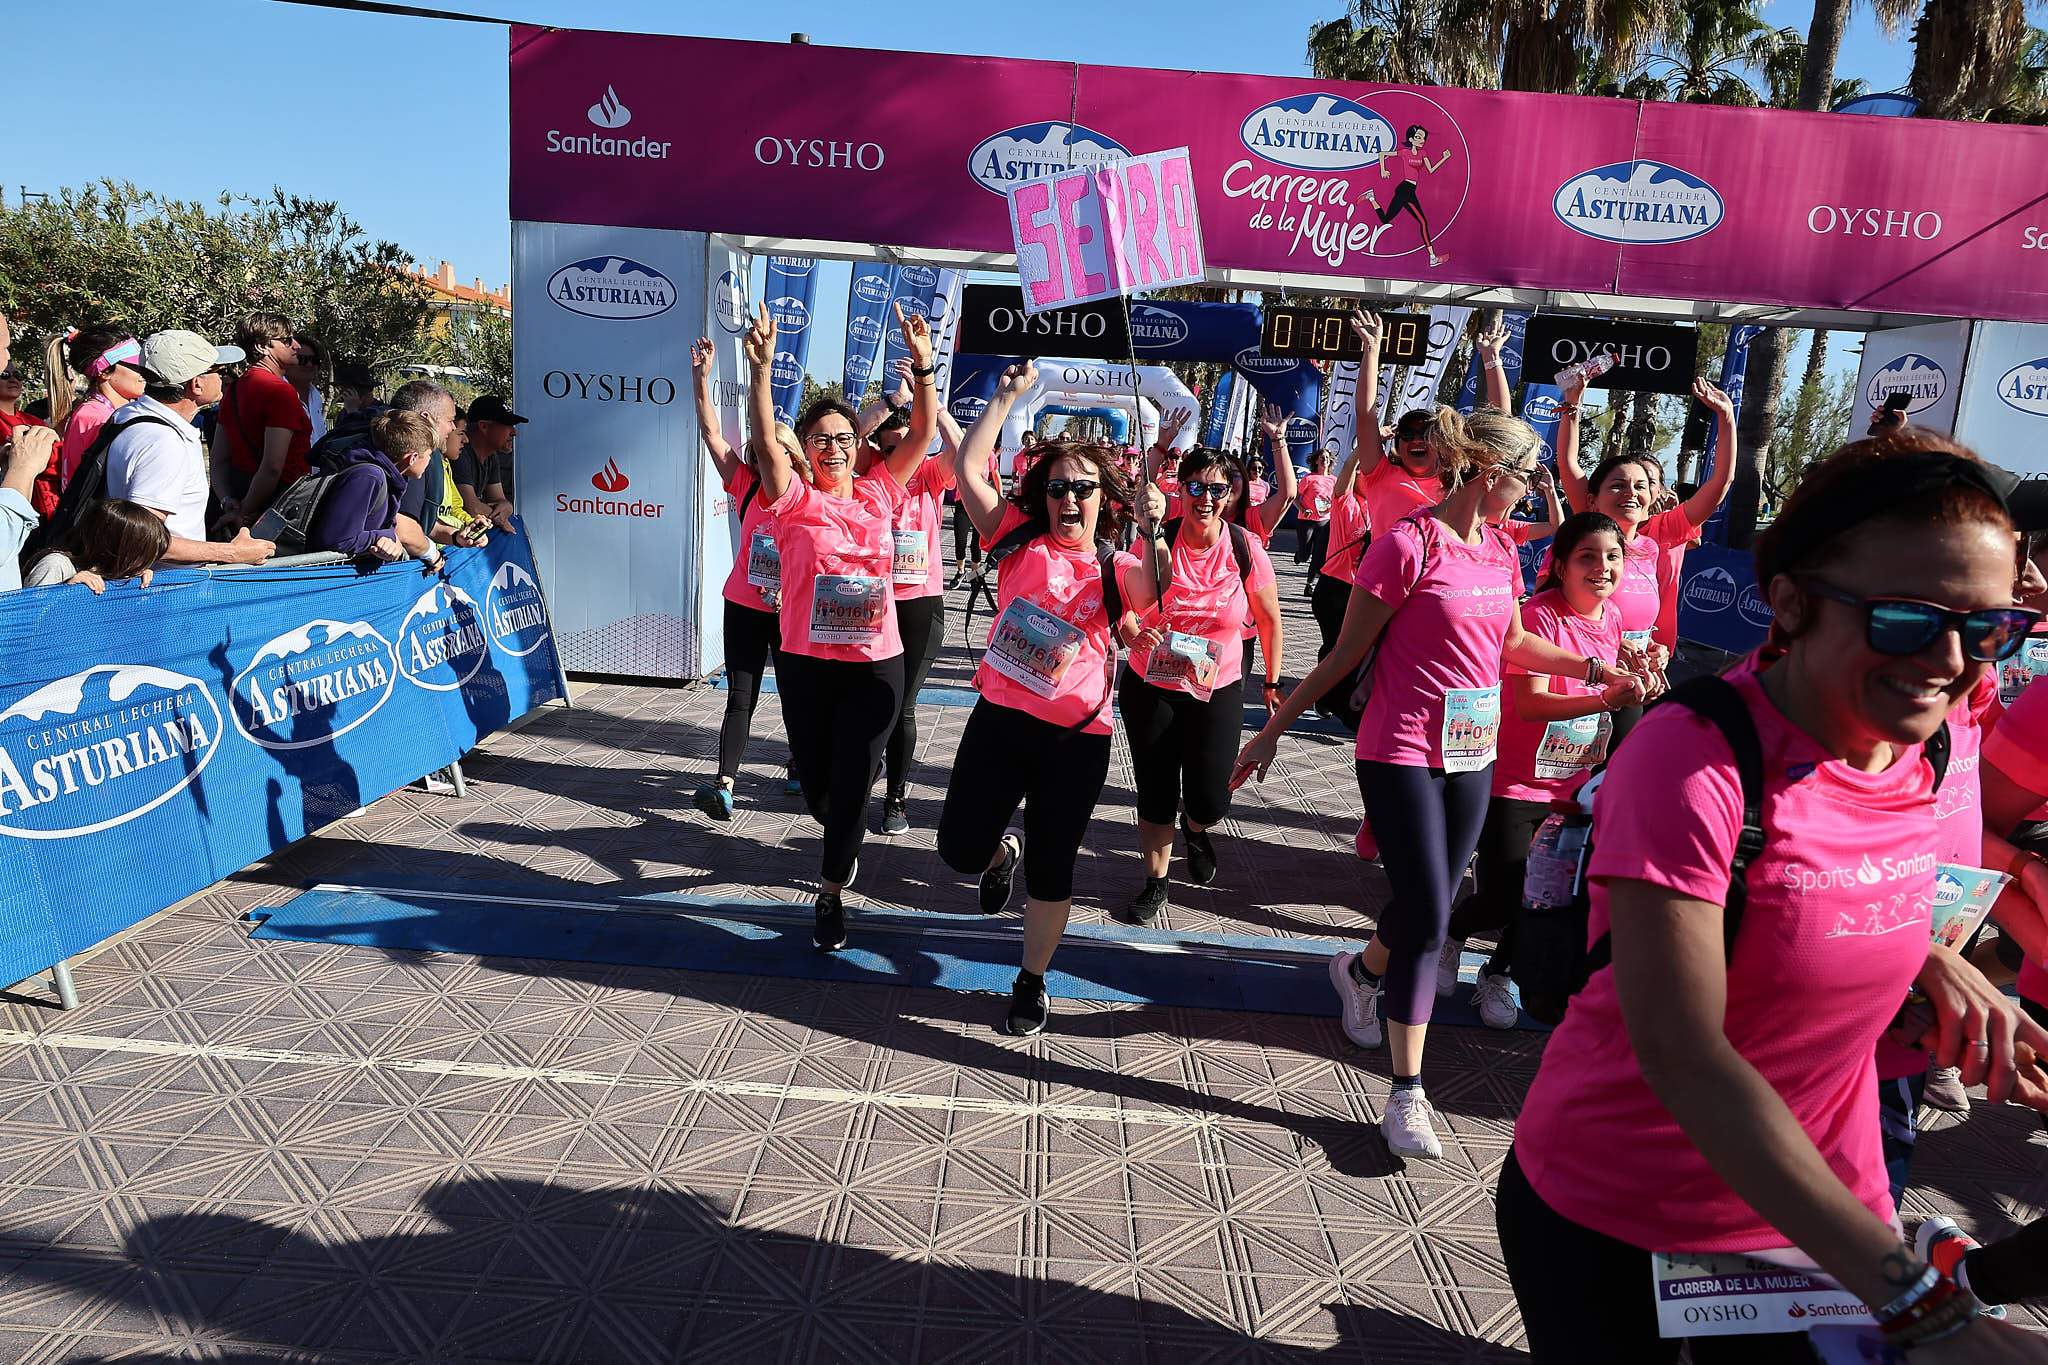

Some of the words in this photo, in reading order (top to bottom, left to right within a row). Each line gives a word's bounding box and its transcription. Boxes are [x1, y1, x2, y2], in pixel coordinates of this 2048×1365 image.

[1252, 117, 1383, 154] ASTURIANA
[1277, 117, 1327, 128] CENTRAL
[1331, 121, 1381, 132] LECHERA
[546, 130, 672, 159] Santander
[754, 136, 885, 171] OYSHO
[1008, 148, 1062, 159] CENTRAL
[1222, 159, 1354, 207] Carrera
[1594, 186, 1648, 198] CENTRAL
[1652, 190, 1707, 201] LECHERA
[1564, 187, 1709, 226] ASTURIANA
[1249, 202, 1273, 230] de
[1277, 203, 1295, 232] la
[1287, 203, 1393, 268] Mujer
[1806, 205, 1942, 241] OYSHO
[556, 276, 668, 307] ASTURIANA
[576, 275, 619, 285] CENTRAL
[622, 278, 664, 288] LECHERA
[988, 307, 1106, 338] OYSHO
[1130, 324, 1180, 339] URIANA
[1240, 355, 1296, 367] ASTURIANA
[1551, 338, 1672, 372] OYSHO
[543, 370, 676, 406] OYSHO
[1063, 367, 1143, 388] OYSHO
[556, 493, 665, 518] Santander
[1439, 588, 1472, 600] Sports
[1686, 580, 1731, 605] ASTURIANA
[268, 656, 323, 681] CENTRAL
[327, 641, 379, 664] LECHERA
[410, 622, 484, 676] ASTURIANA
[248, 657, 389, 731] ASTURIANA
[27, 714, 114, 750] CENTRAL
[120, 692, 194, 725] LECHERA
[0, 711, 211, 818] ASTURIANA
[1783, 863, 1855, 895] Sports
[1669, 1279, 1723, 1296] CARRERA
[1725, 1278, 1743, 1292] DE
[1745, 1278, 1761, 1291] LA
[1764, 1275, 1811, 1290] MUJER
[1684, 1303, 1758, 1323] OYSHO
[1807, 1303, 1870, 1317] Santand
